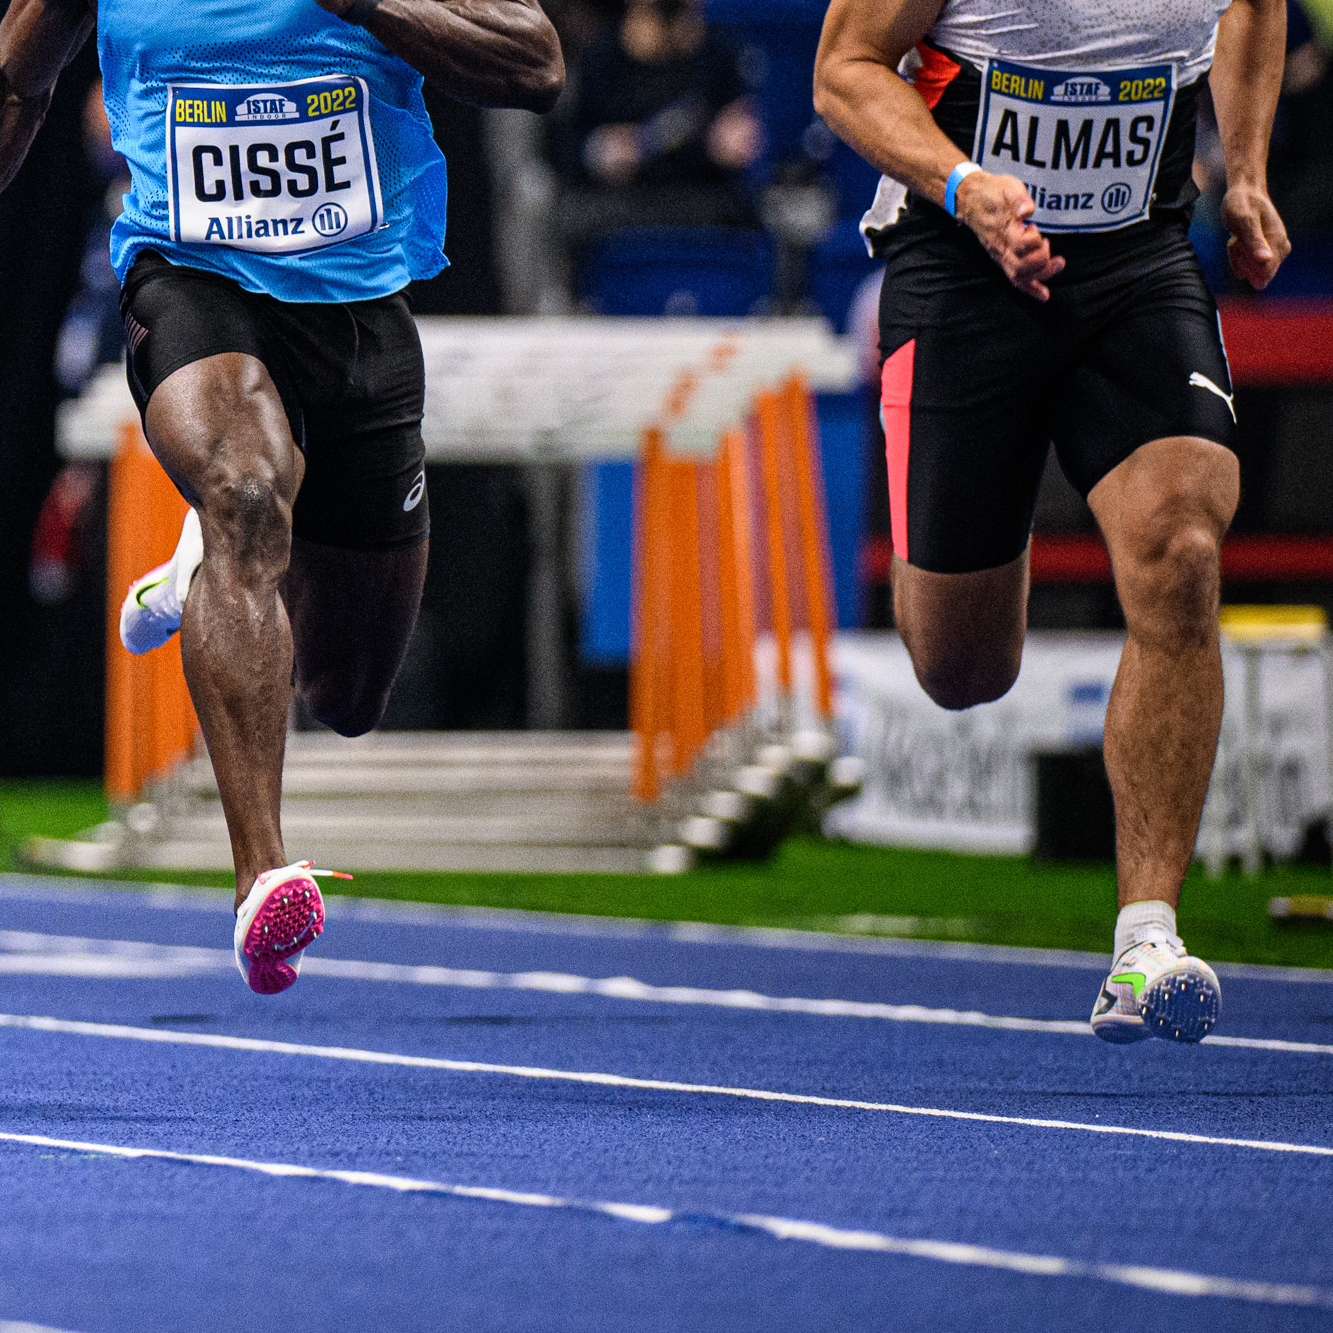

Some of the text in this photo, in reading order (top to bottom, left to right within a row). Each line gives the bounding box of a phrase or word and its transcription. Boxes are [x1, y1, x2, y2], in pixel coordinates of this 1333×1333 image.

[991, 70, 1166, 101] BERLIN ISTAF 2022
[175, 86, 356, 123] BERLIN ISTAF 2022
[991, 108, 1156, 171] ALMAS
[192, 120, 350, 202] CISSÉ
[1024, 182, 1095, 211] lianz
[205, 215, 305, 241] Allianz
